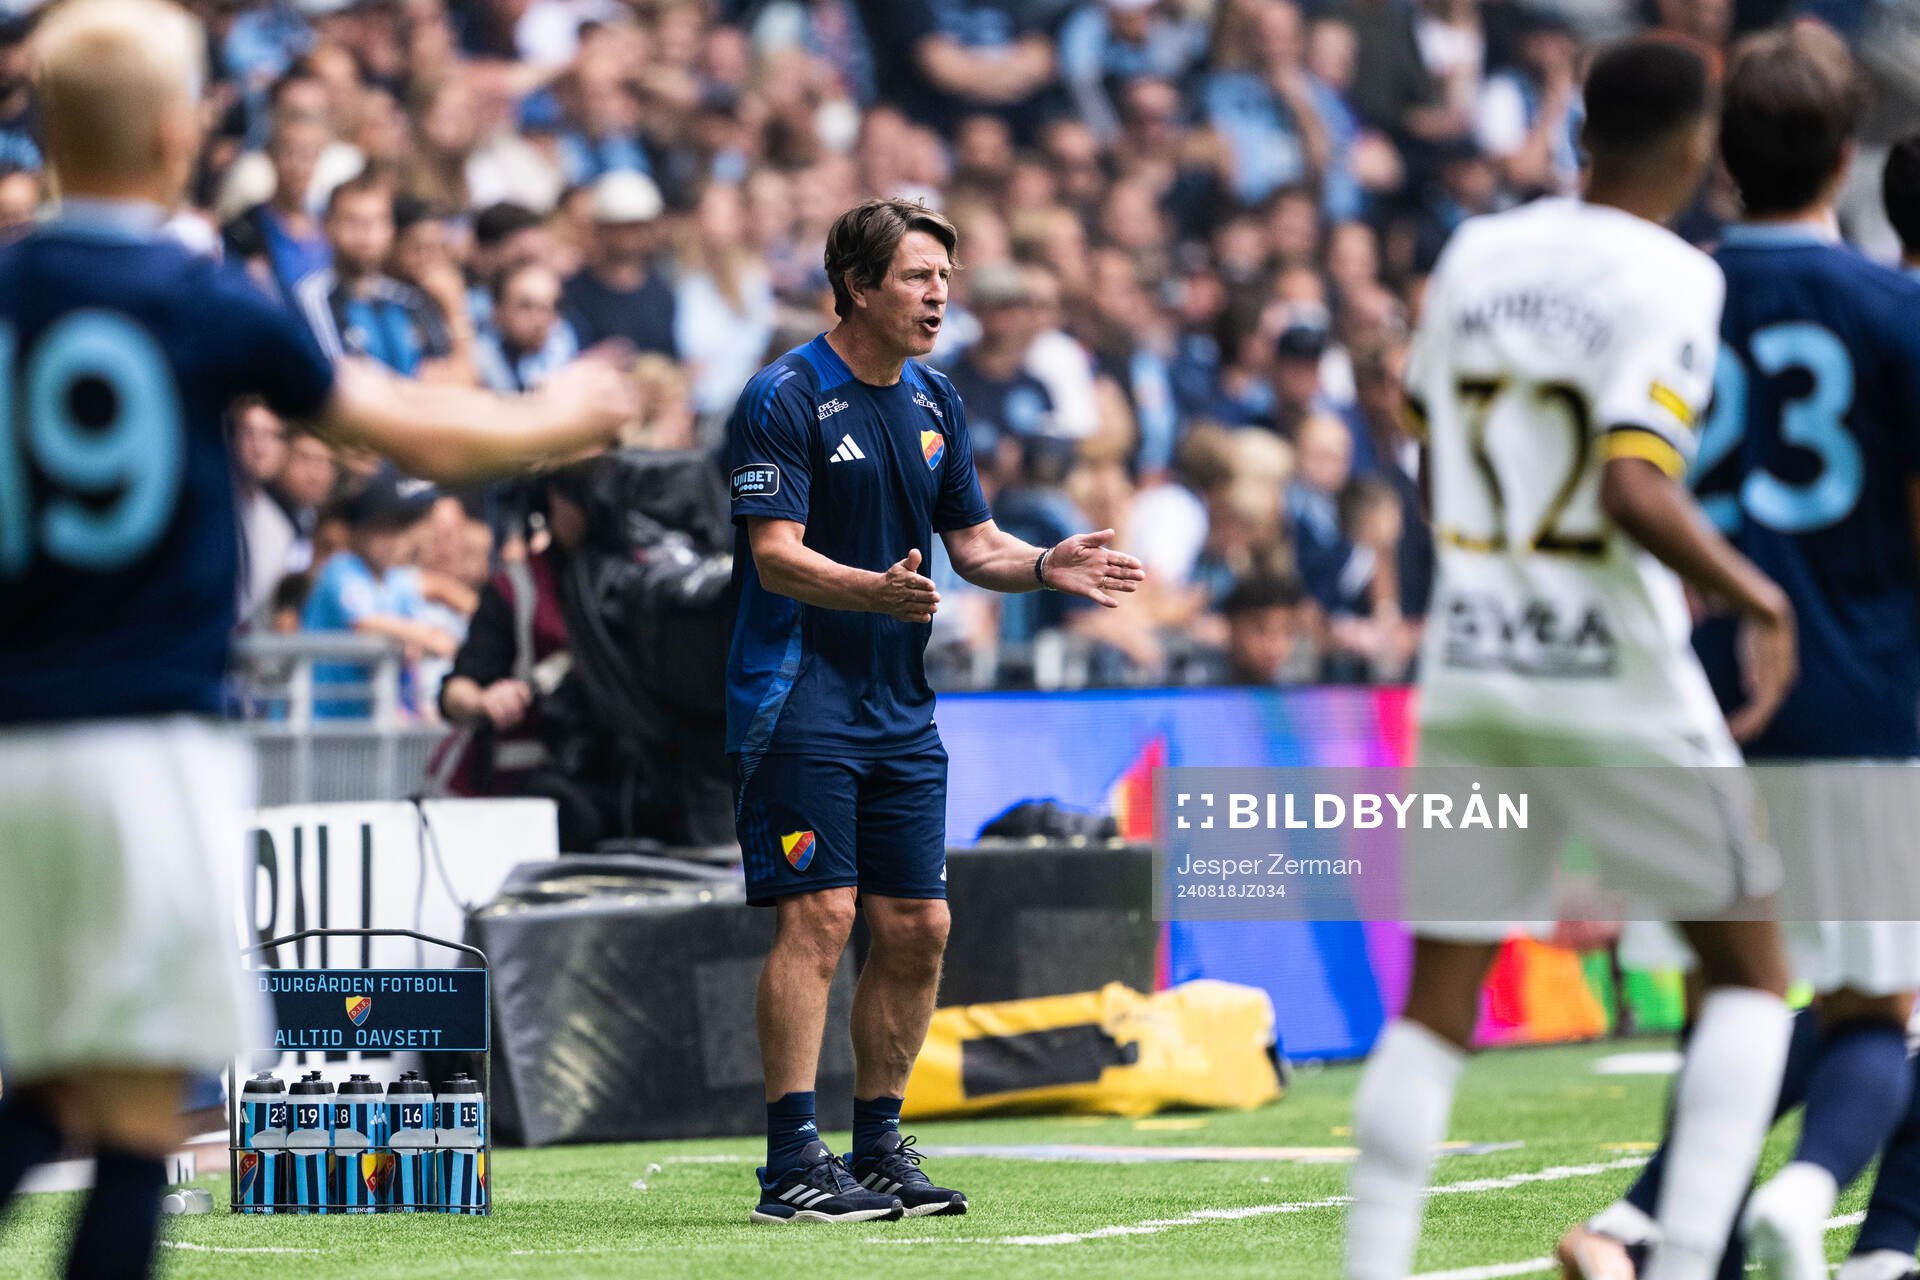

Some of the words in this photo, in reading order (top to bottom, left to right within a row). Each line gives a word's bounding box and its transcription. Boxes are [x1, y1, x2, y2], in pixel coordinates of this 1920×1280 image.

[733, 470, 774, 487] UNIBET
[258, 975, 375, 993] DJURGÅRDEN
[381, 977, 458, 993] FOTBOLL
[274, 1029, 343, 1046] ALLTID
[355, 1029, 443, 1046] OAVSETT
[299, 1108, 318, 1124] 19
[335, 1108, 349, 1123] 18
[404, 1108, 422, 1123] 16
[463, 1107, 477, 1122] 15
